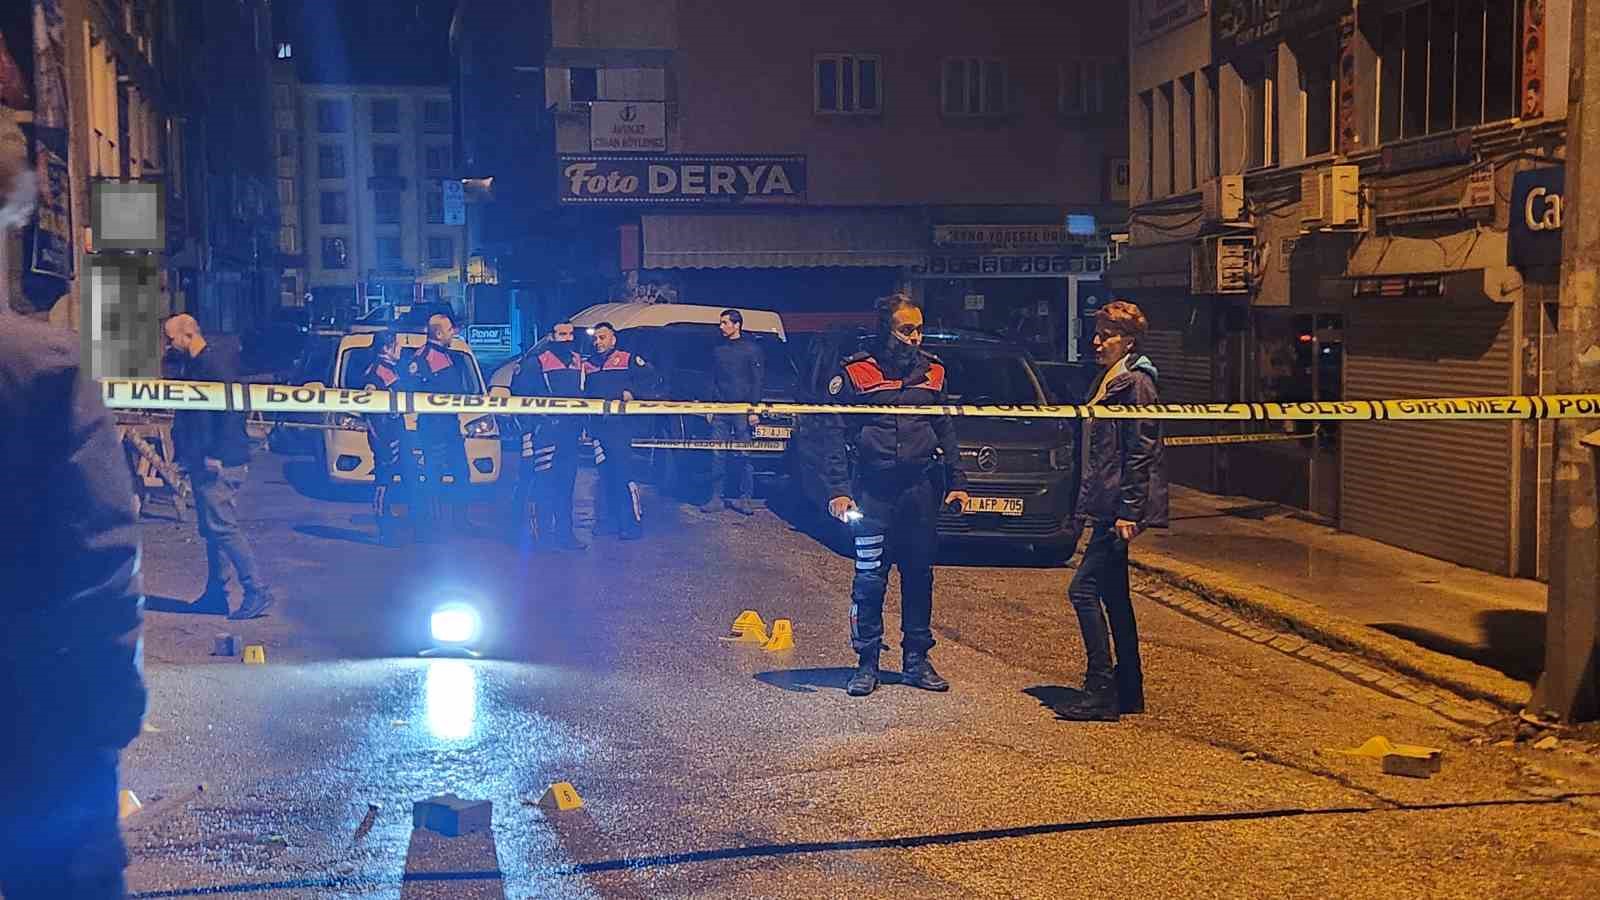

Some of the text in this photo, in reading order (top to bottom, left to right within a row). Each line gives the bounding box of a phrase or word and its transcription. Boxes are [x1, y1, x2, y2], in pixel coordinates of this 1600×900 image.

[564, 162, 793, 195] Foto DERYA
[980, 499, 997, 510] AFP
[1004, 500, 1021, 511] 705
[563, 790, 571, 802] 5
